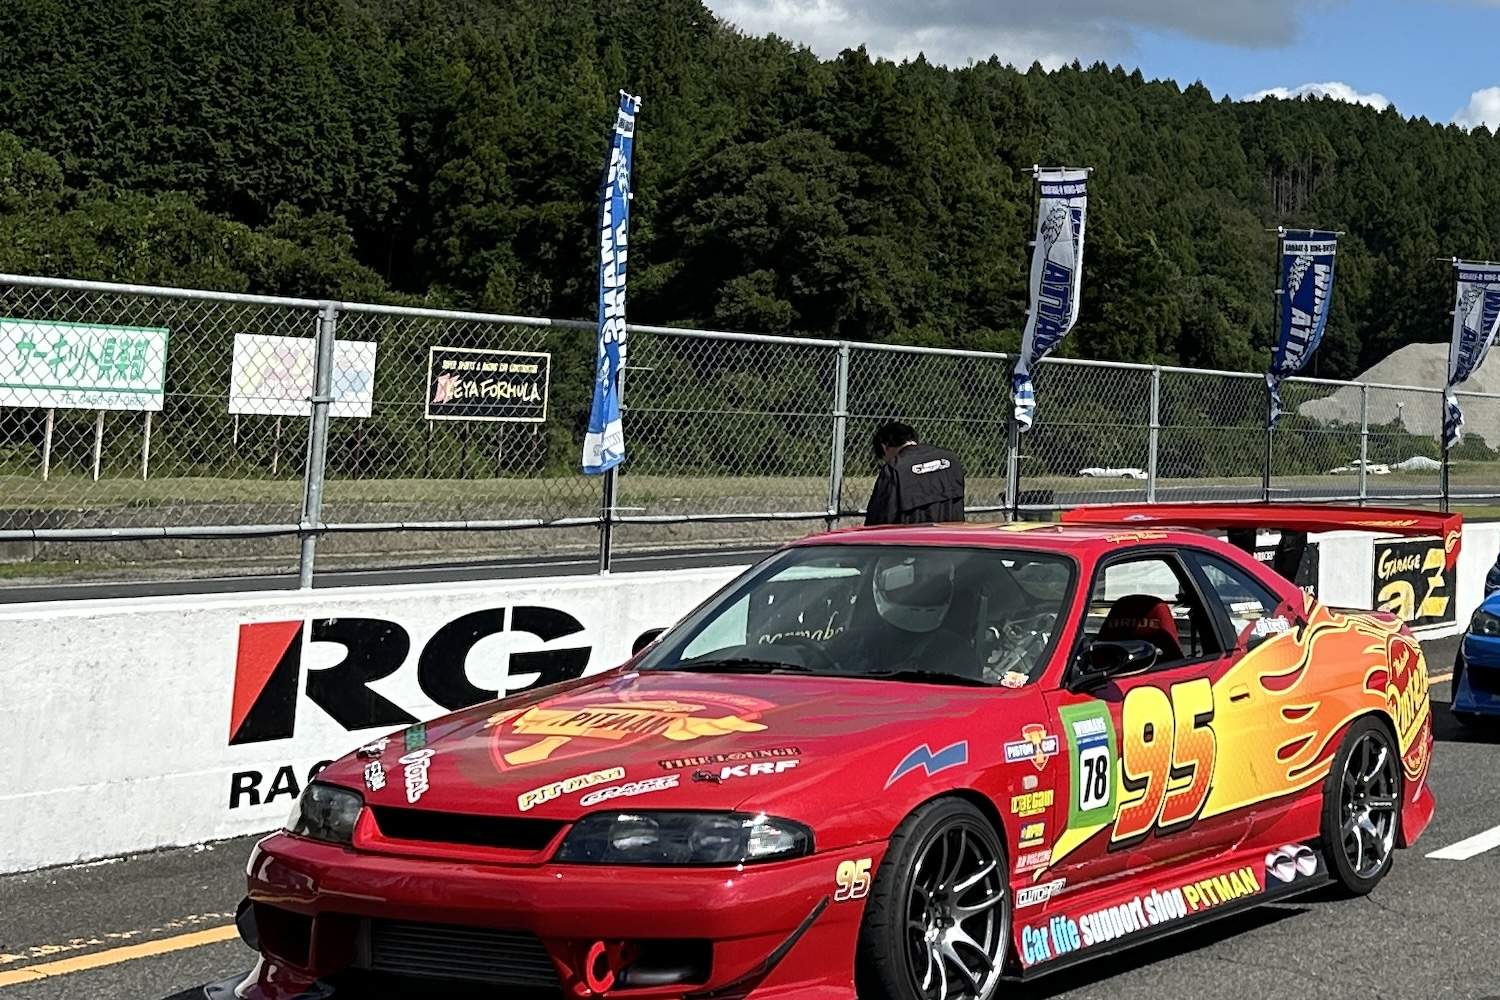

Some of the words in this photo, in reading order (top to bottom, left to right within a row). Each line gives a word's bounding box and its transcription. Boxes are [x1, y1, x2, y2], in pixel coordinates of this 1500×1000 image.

[480, 379, 541, 401] FORMULA
[1378, 548, 1420, 580] GARAGE
[720, 759, 800, 780] KRF
[1007, 743, 1034, 759] PISTON
[1107, 679, 1219, 853] 95
[1083, 755, 1108, 804] 78
[834, 857, 873, 901] 95
[1021, 925, 1051, 966] Car
[1050, 915, 1081, 955] life
[1079, 896, 1149, 946] support
[1143, 888, 1188, 926] shop
[1182, 866, 1261, 911] PITMAN
